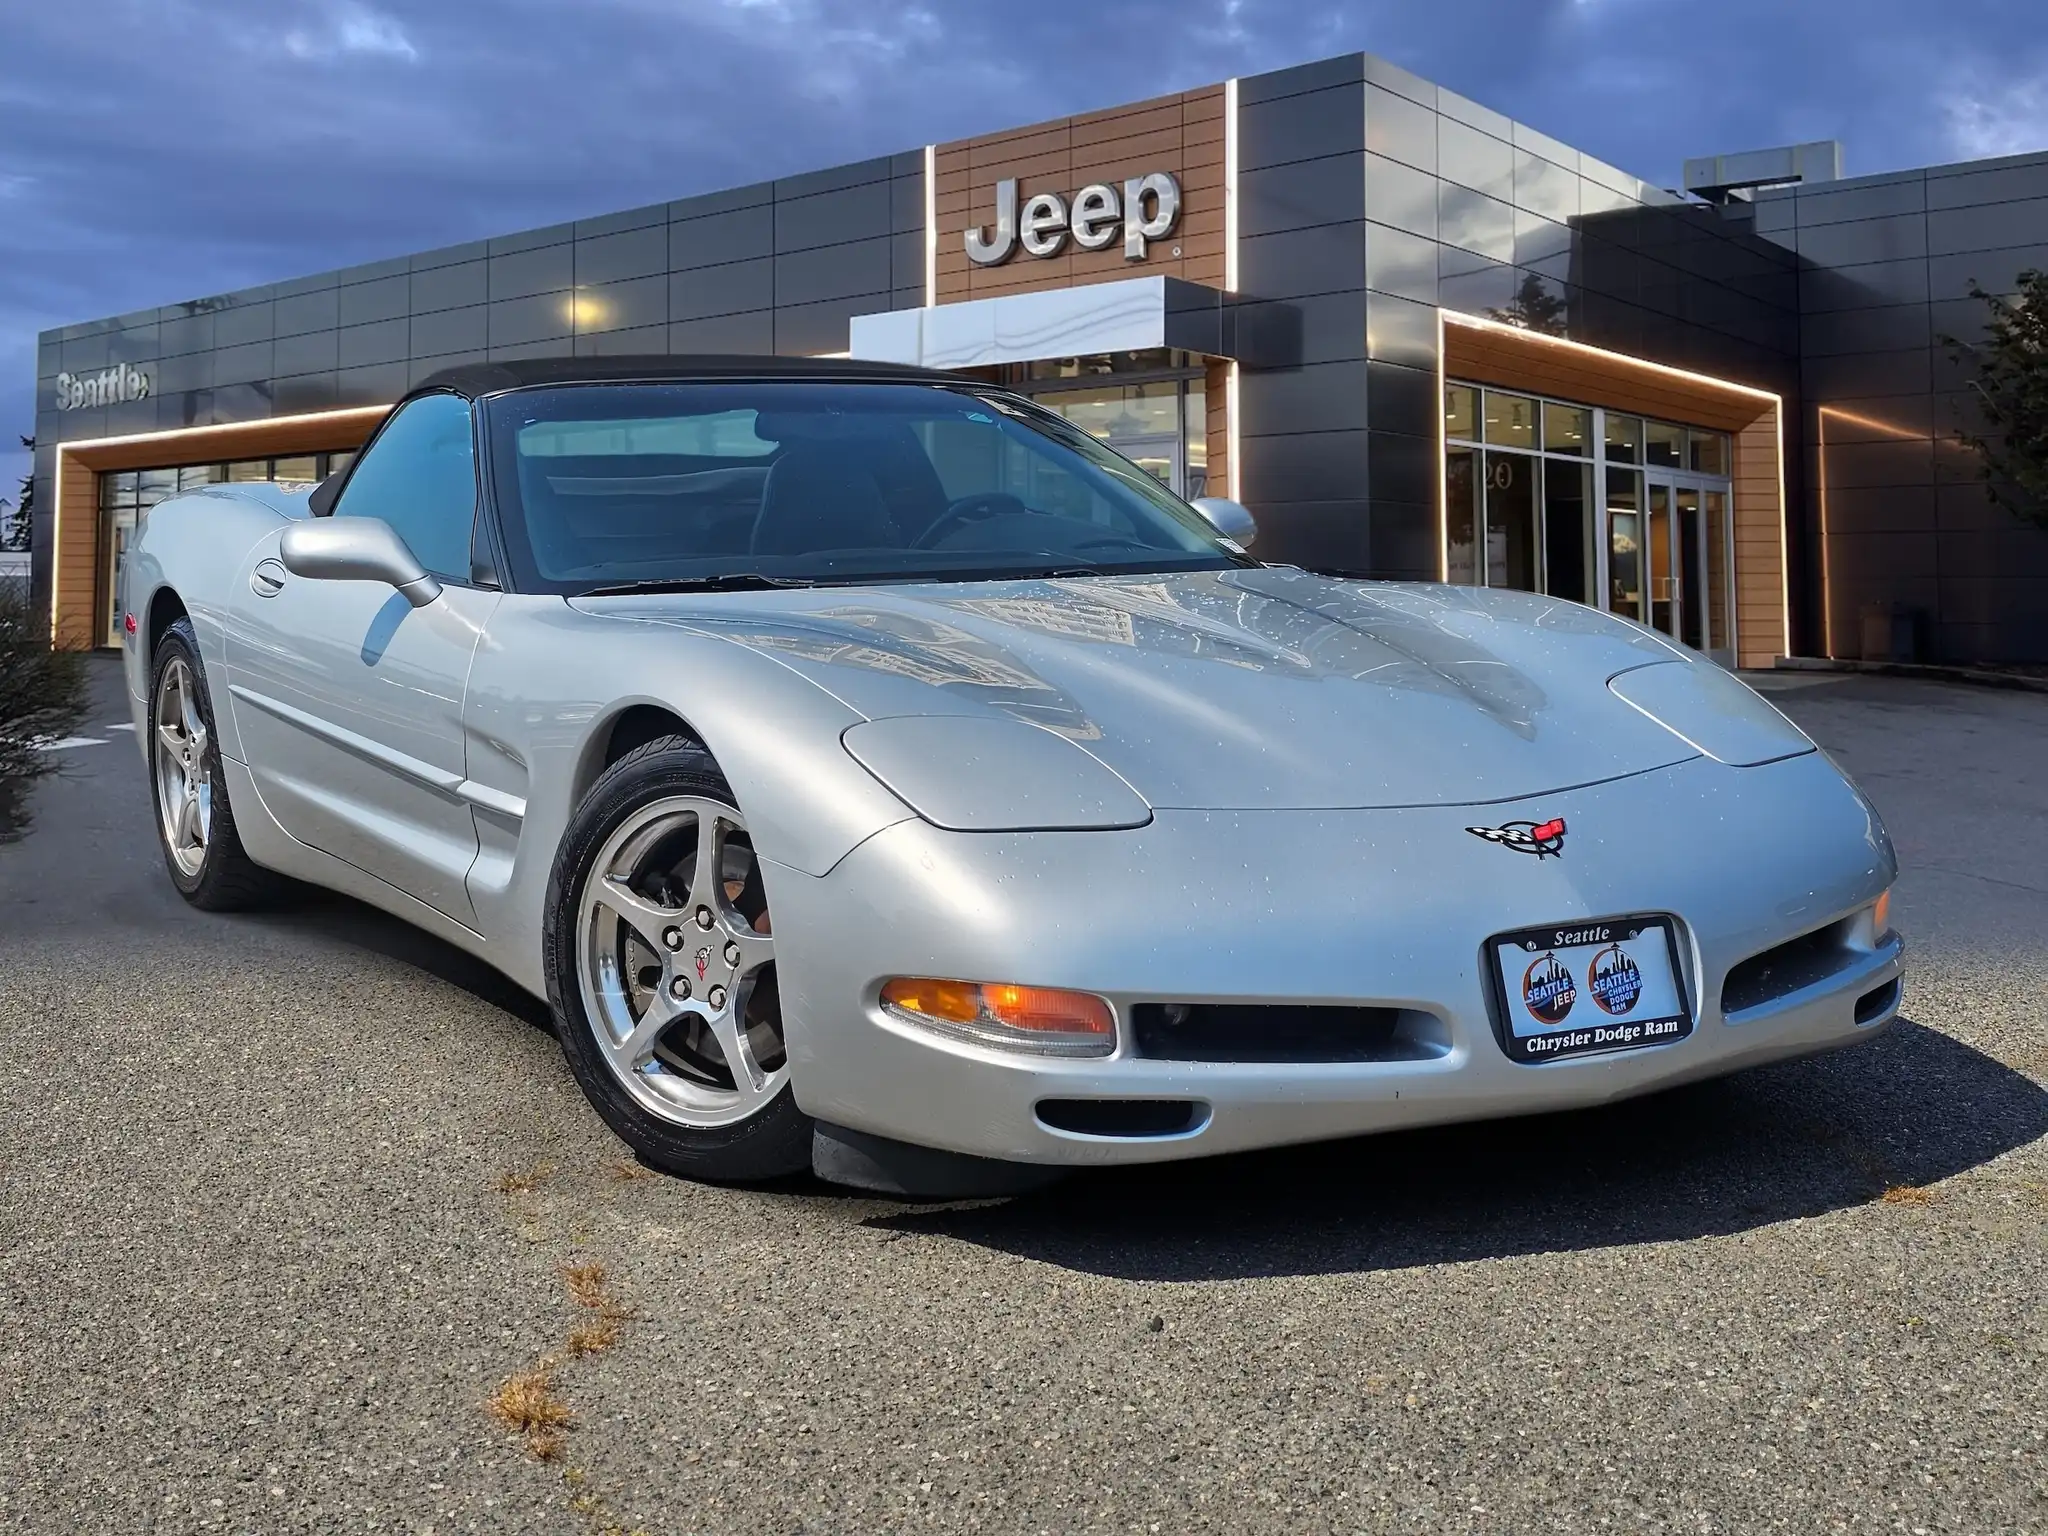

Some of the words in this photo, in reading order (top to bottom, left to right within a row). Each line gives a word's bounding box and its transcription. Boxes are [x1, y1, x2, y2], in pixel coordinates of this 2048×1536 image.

[964, 171, 1182, 267] Jeep
[1554, 926, 1610, 946] Seattle
[1527, 978, 1570, 1001] SEATTLE
[1593, 969, 1636, 993] SEATTLE
[1608, 980, 1643, 997] CHRYSLER
[1553, 990, 1576, 1011] JEEP
[1609, 990, 1635, 1005] DODGE
[1611, 1003, 1627, 1014] RAM
[1526, 1033, 1591, 1053] Chrysler
[1594, 1026, 1640, 1043] Dodge
[1644, 1021, 1678, 1036] Ram
